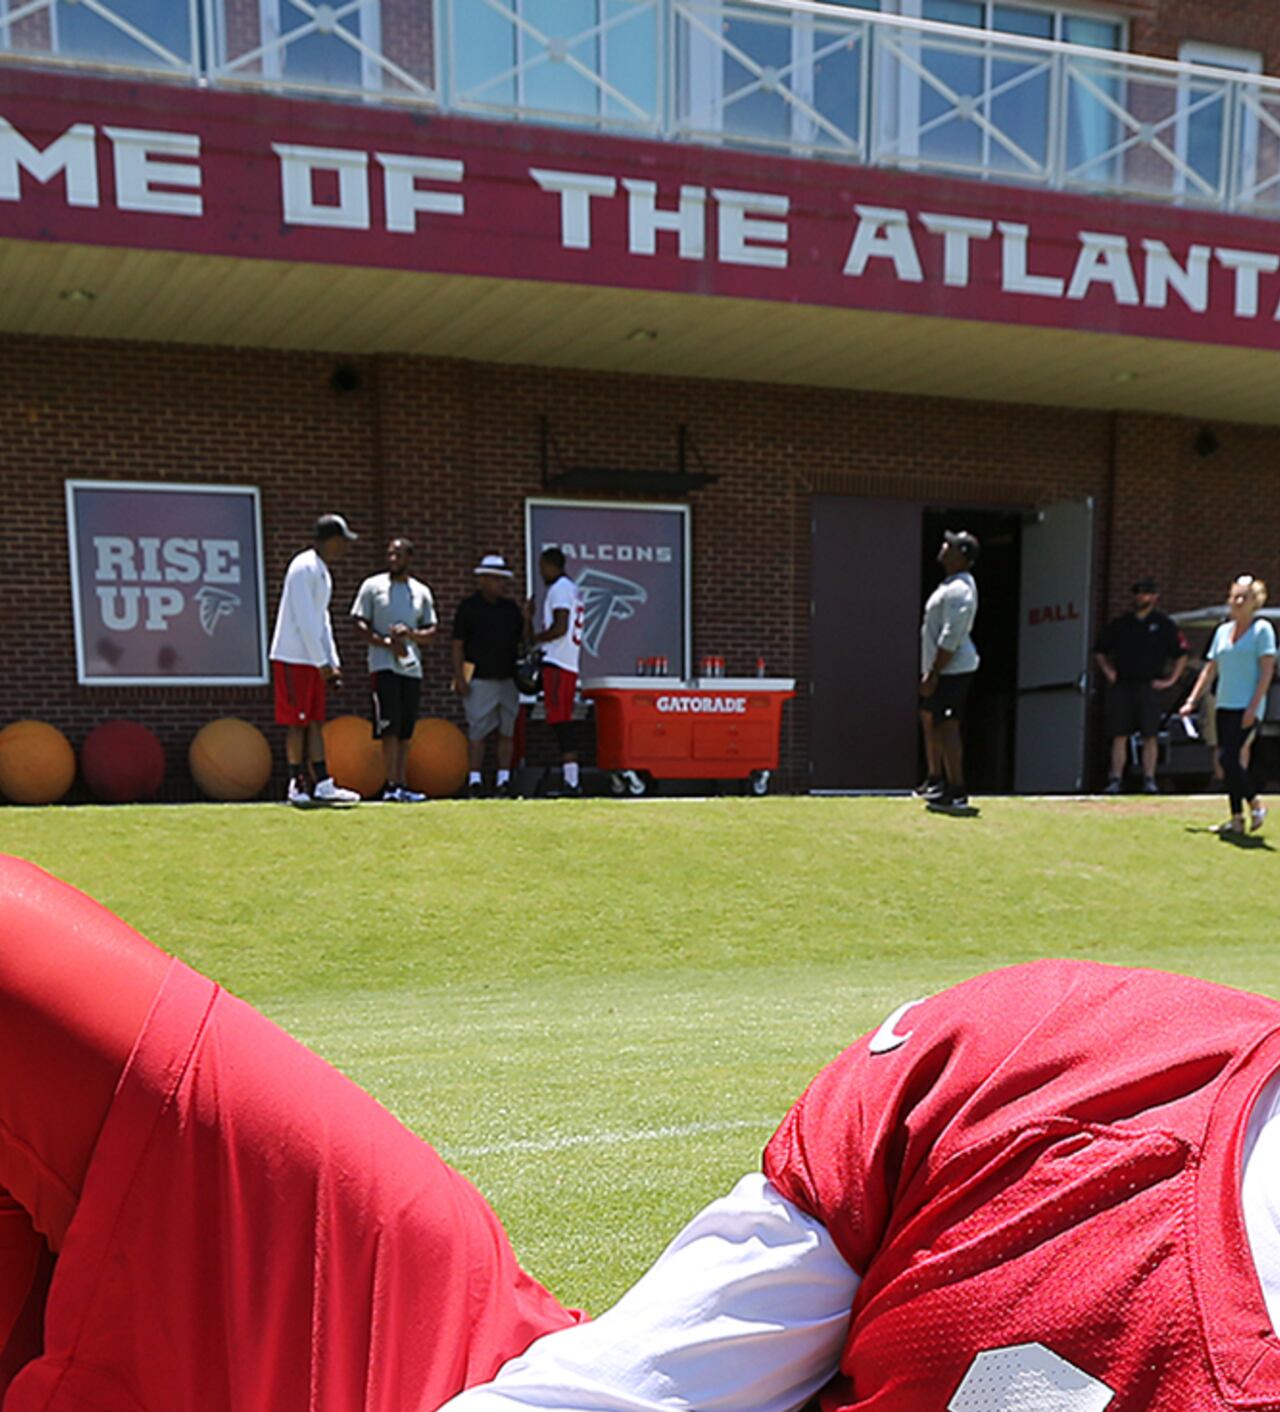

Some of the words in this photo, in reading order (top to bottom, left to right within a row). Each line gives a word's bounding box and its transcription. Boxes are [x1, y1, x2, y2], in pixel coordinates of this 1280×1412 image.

[271, 141, 465, 233] OF
[528, 167, 789, 269] THE
[92, 535, 241, 583] RISE
[96, 586, 185, 631] UP
[656, 696, 747, 713] GATORADE
